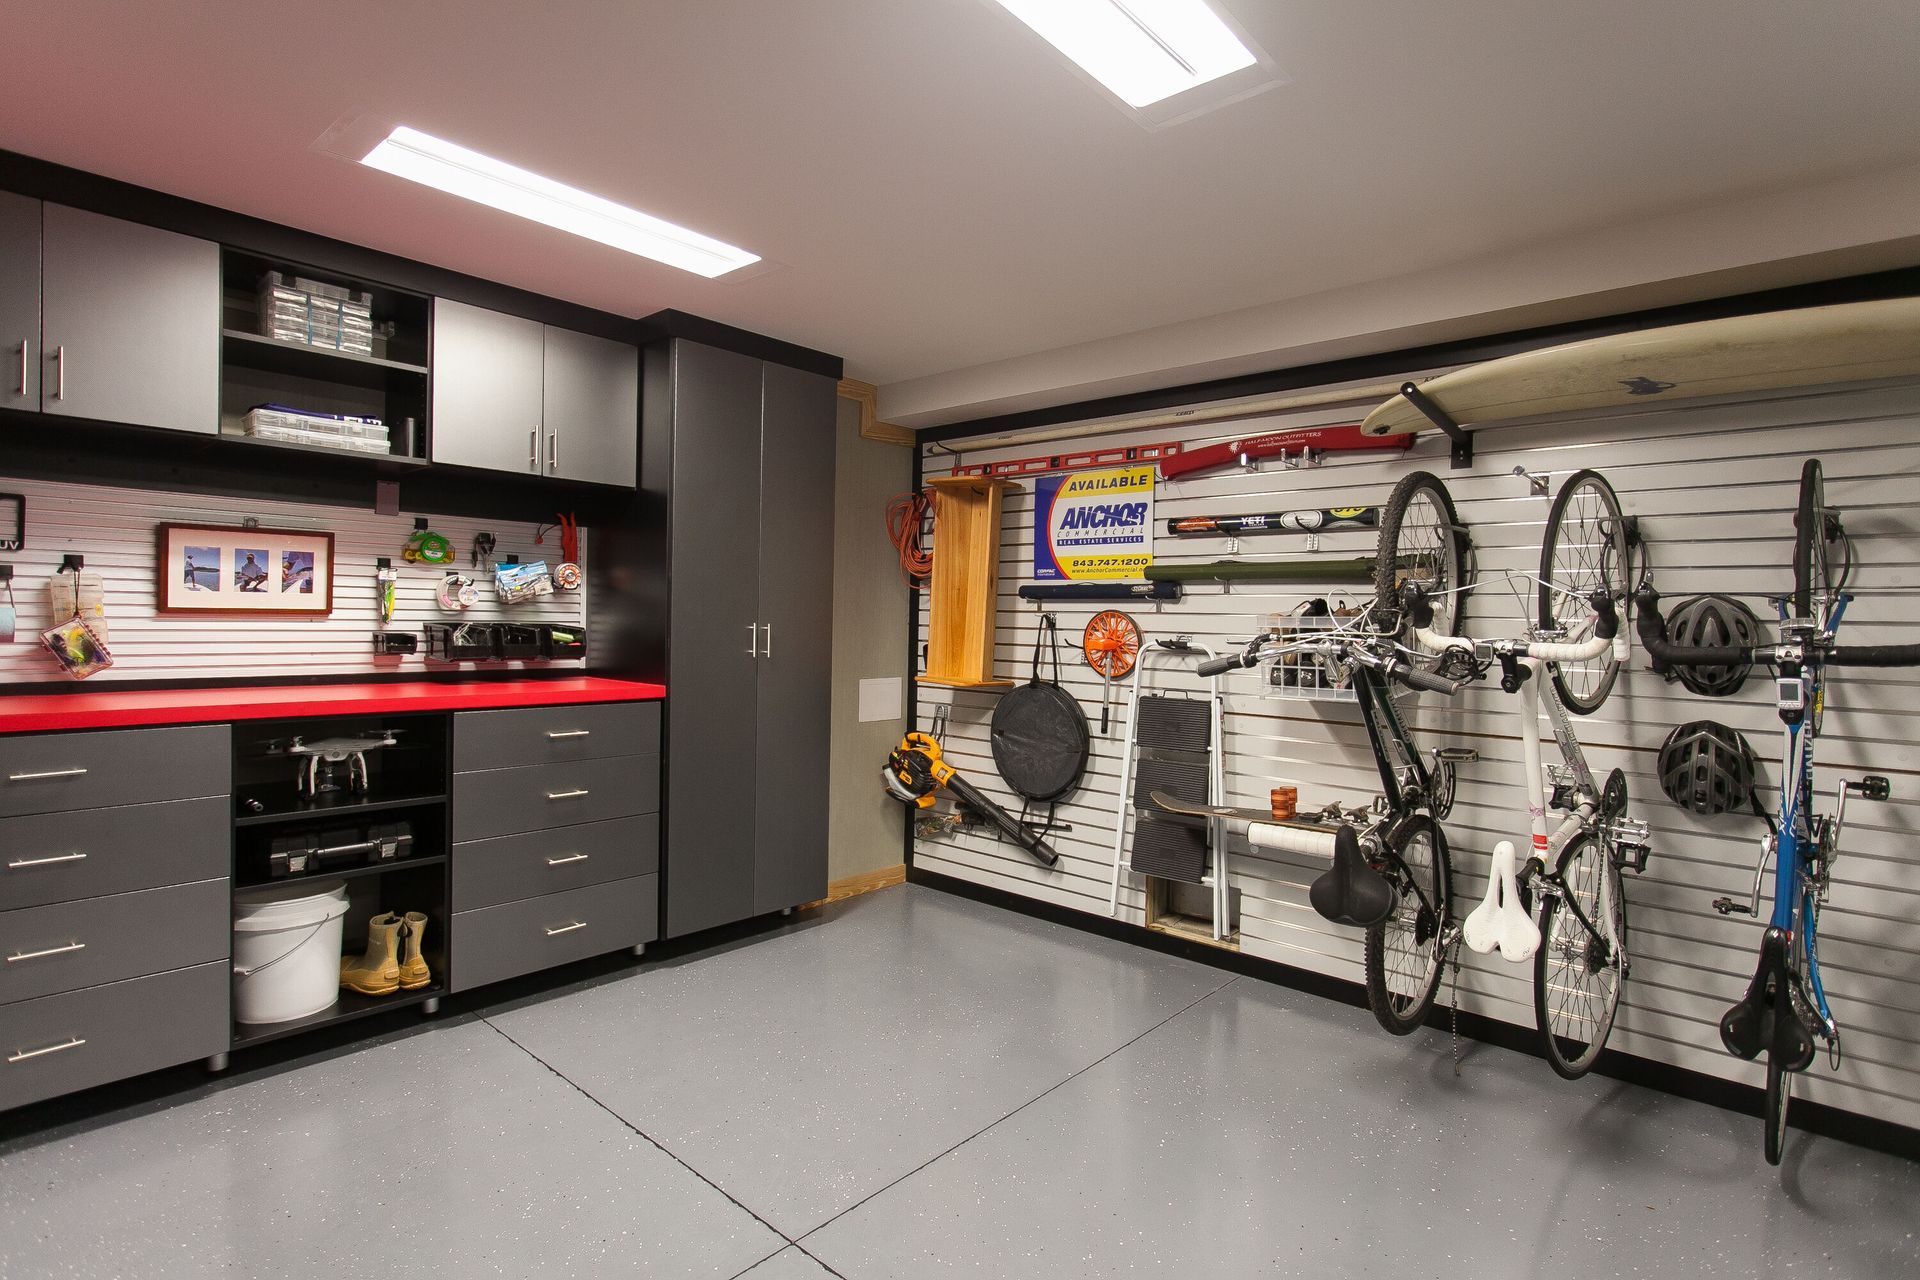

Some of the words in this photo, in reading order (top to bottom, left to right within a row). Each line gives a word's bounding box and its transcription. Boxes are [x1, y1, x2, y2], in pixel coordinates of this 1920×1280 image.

[1068, 474, 1148, 492] AVAILABLE
[1060, 502, 1148, 530] ANCHOR
[1241, 515, 1266, 525] YETI
[1057, 528, 1143, 538] COMMERCIAL
[1107, 536, 1142, 544] SERVICES
[1072, 558, 1149, 567] 843.747.1200
